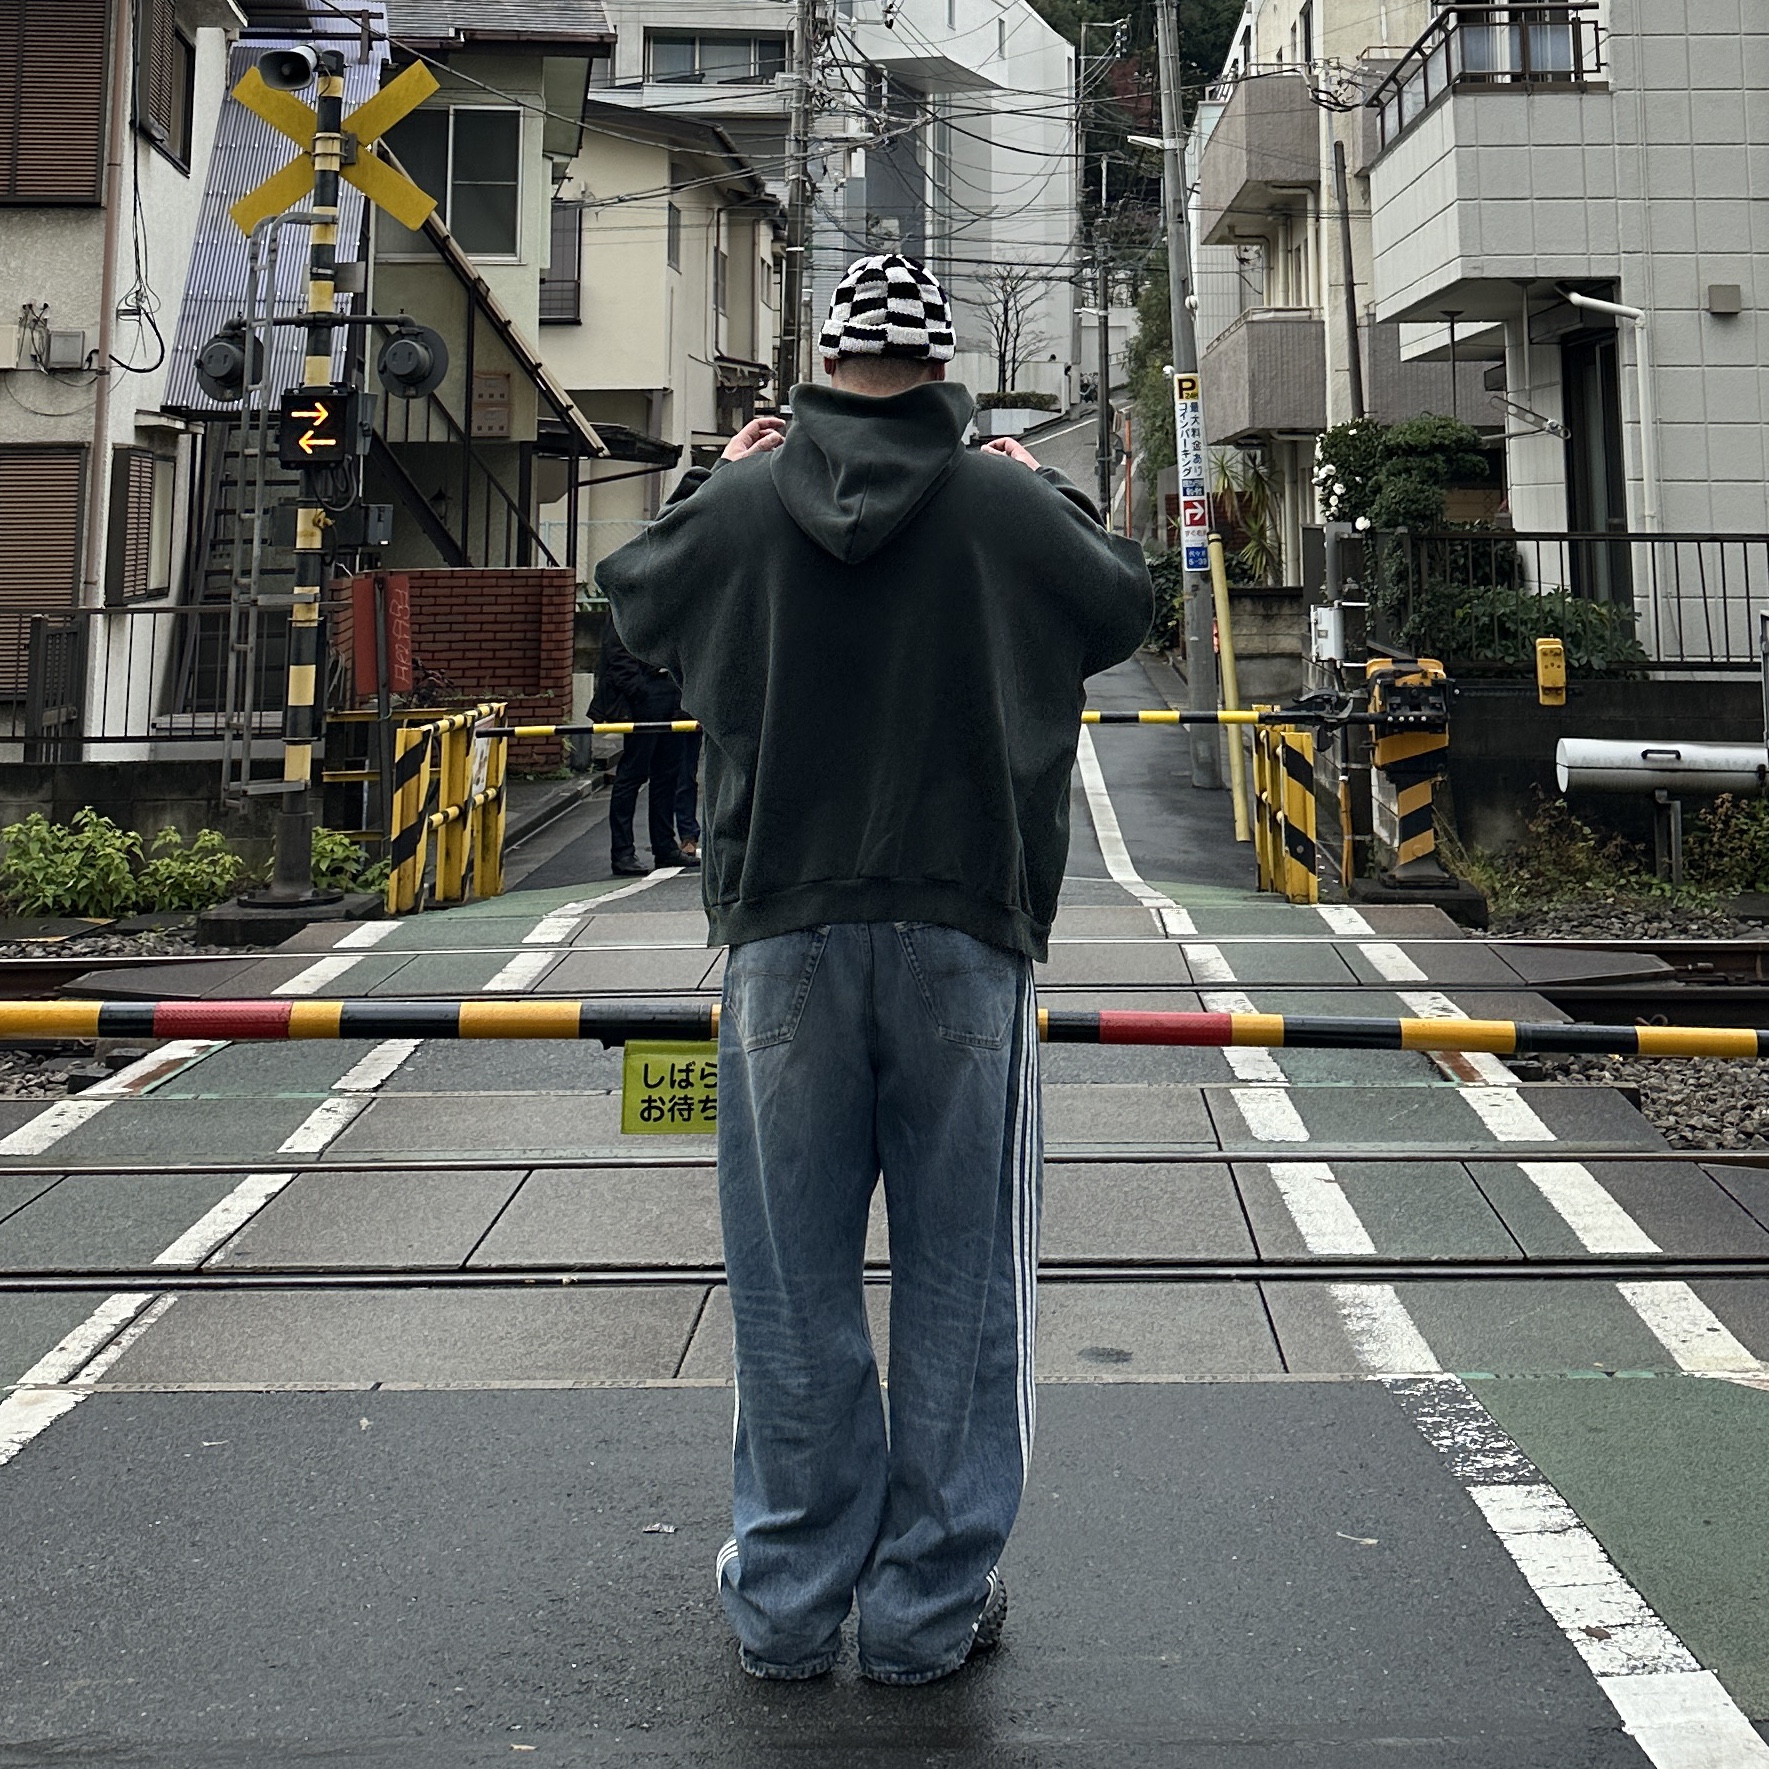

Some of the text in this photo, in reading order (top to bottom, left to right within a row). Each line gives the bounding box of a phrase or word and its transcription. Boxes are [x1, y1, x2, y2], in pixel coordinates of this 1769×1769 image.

[1178, 378, 1196, 399] P
[1190, 402, 1202, 476] 最大料金あり
[643, 1061, 717, 1089] しばら
[640, 1094, 717, 1123] お待ち
